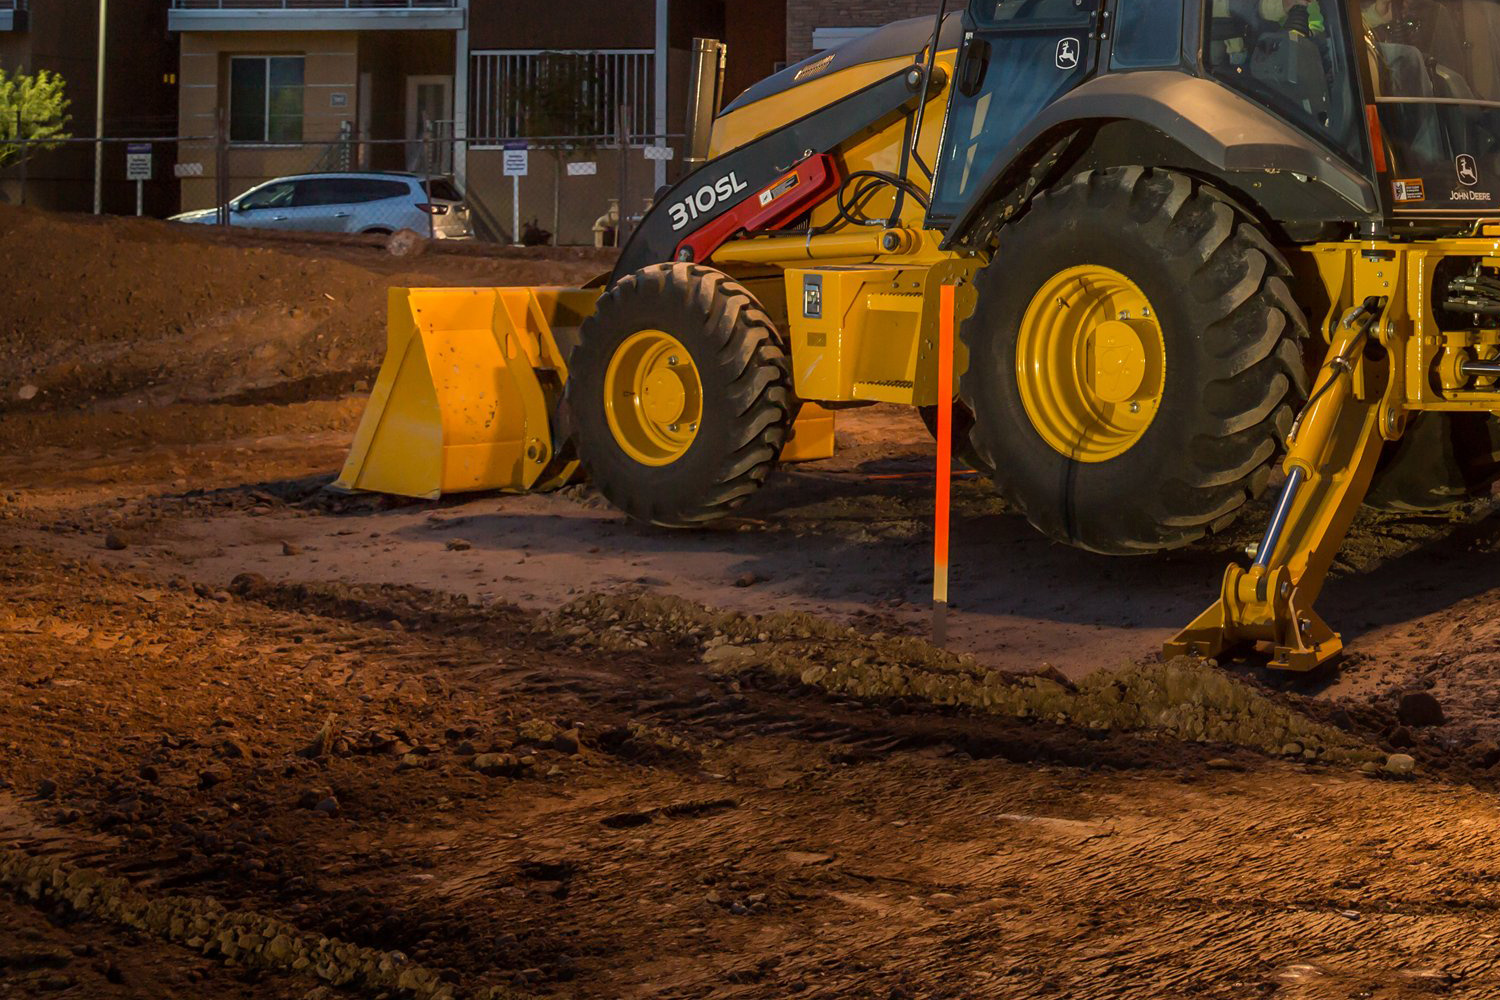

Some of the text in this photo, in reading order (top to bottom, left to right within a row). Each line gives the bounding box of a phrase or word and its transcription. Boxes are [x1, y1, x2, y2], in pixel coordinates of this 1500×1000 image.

[668, 171, 748, 231] 310SL
[1449, 190, 1491, 201] JOHN DEERE
